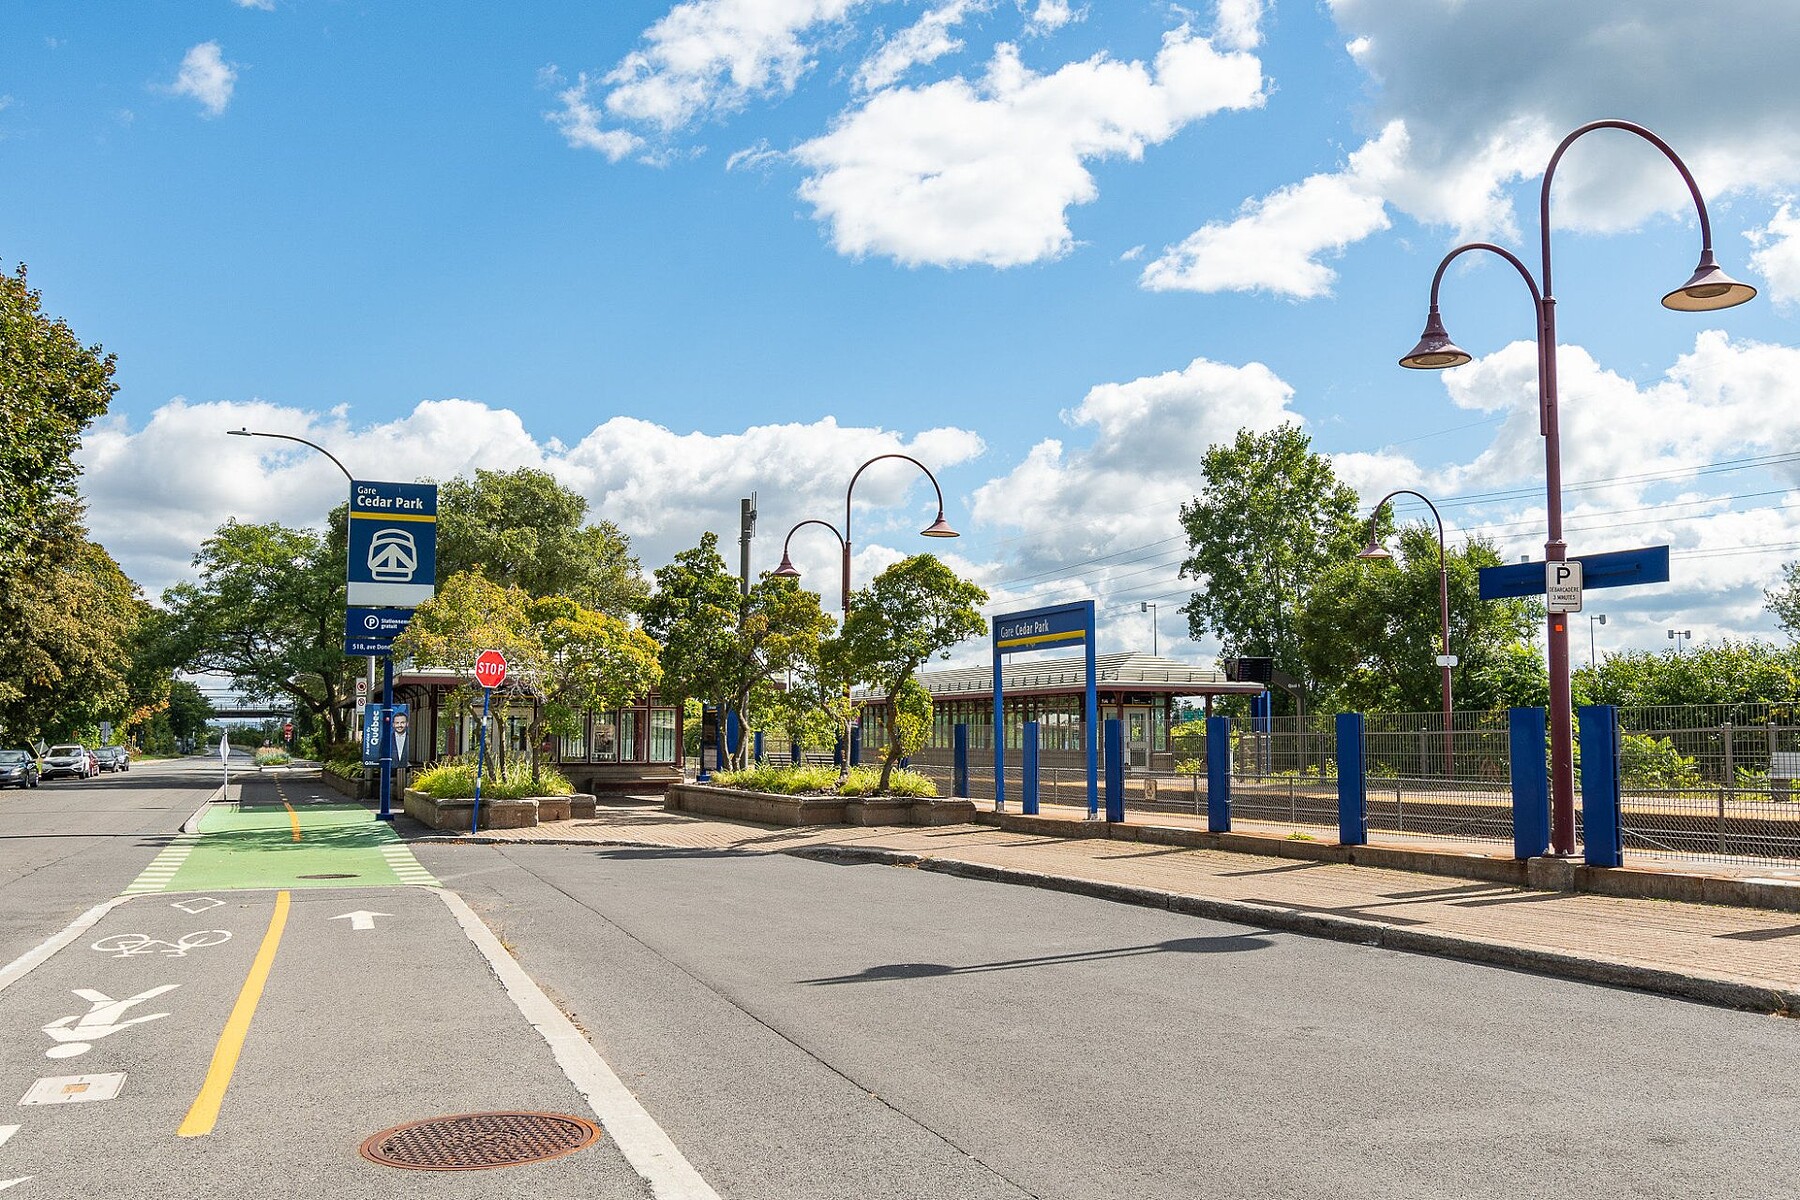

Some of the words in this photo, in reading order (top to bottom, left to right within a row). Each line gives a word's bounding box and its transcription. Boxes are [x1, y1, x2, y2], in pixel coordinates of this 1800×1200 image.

[357, 486, 376, 494] Gare
[357, 495, 392, 508] Cedar
[396, 497, 423, 509] Park
[1556, 567, 1571, 585] P
[1001, 627, 1014, 638] Gare
[1016, 622, 1033, 635] Cedar
[1035, 619, 1049, 633] Park
[478, 662, 504, 675] STOP
[370, 710, 379, 745] Québec
